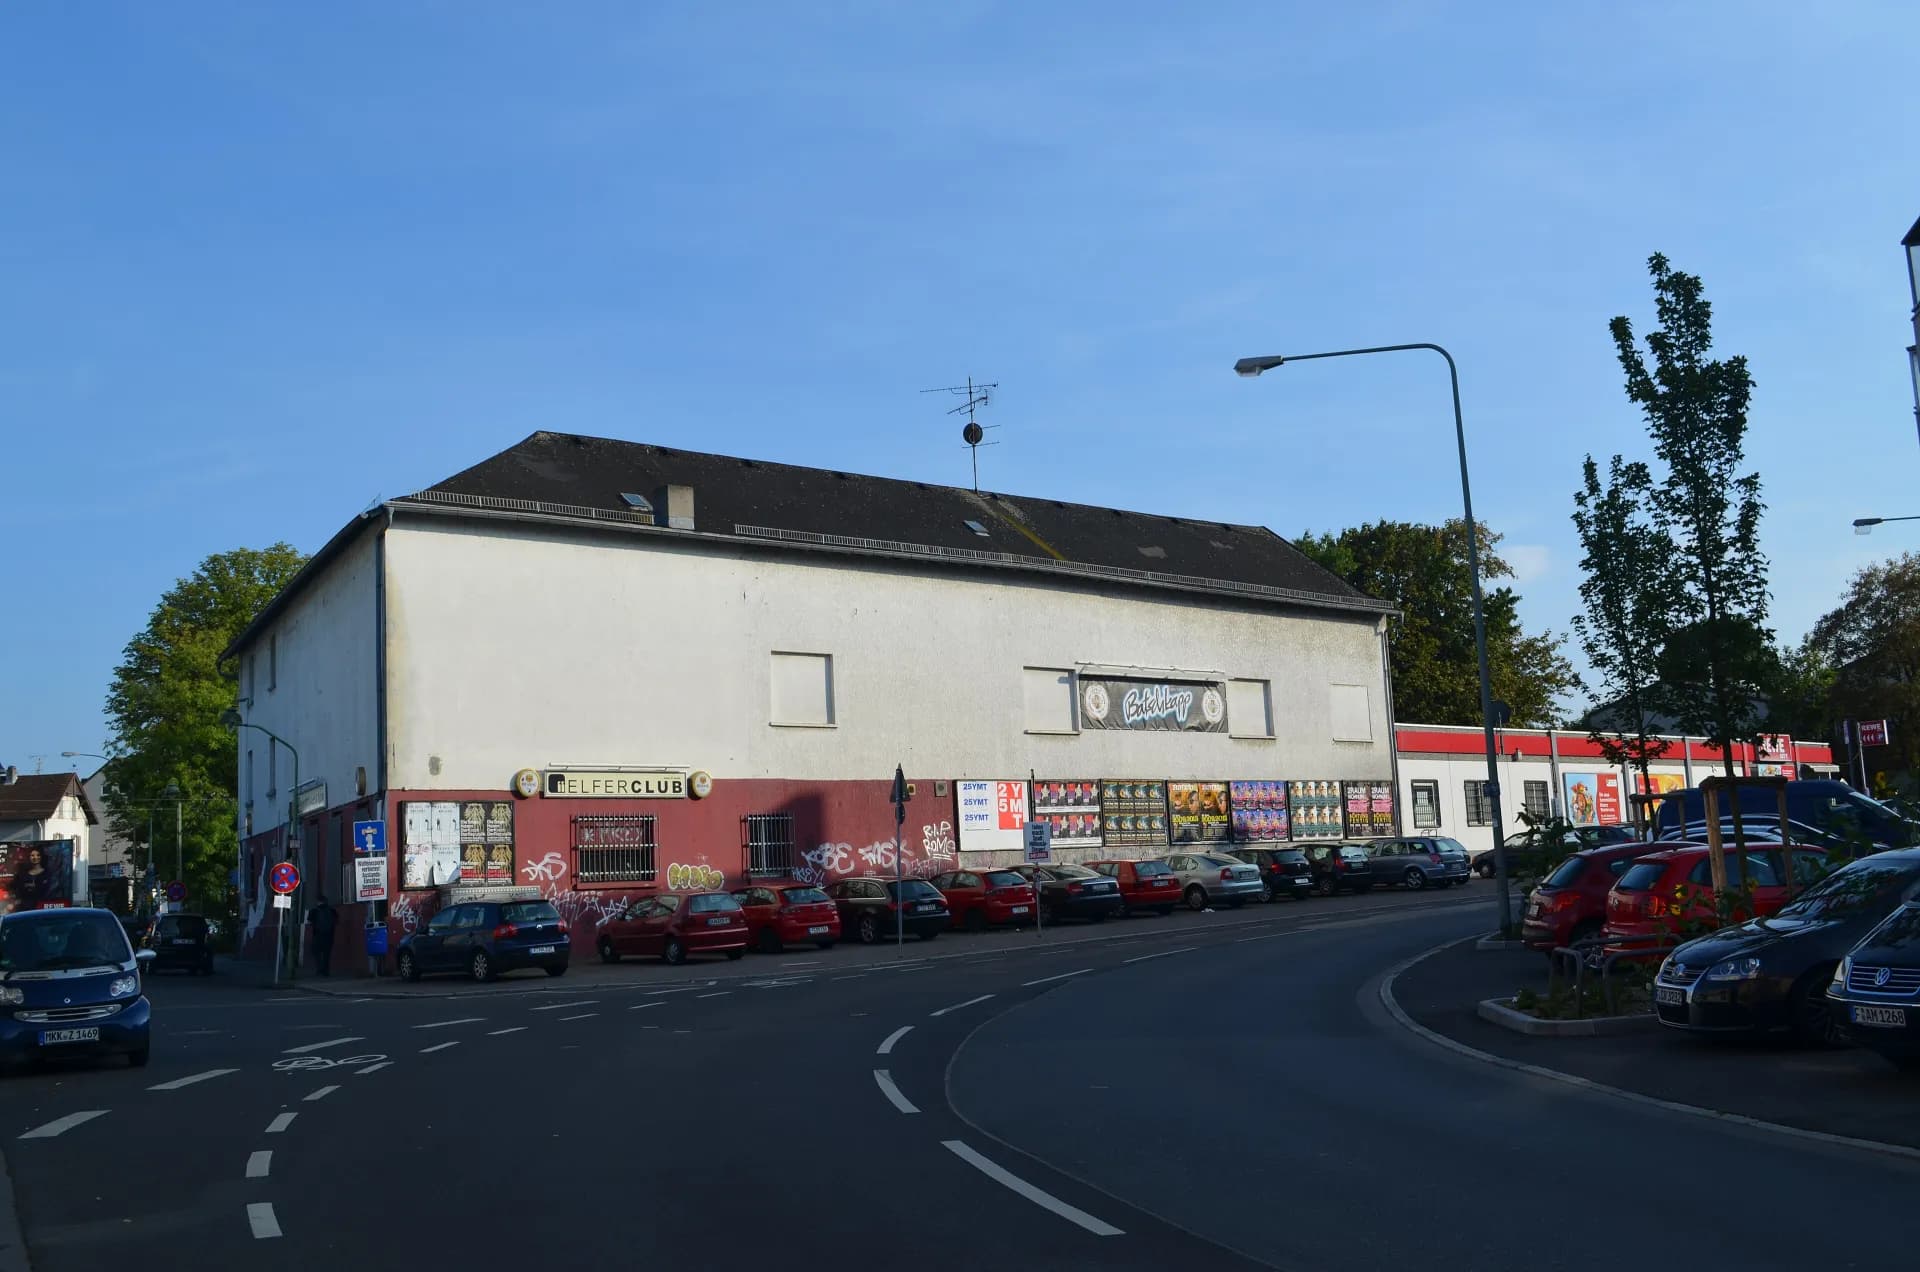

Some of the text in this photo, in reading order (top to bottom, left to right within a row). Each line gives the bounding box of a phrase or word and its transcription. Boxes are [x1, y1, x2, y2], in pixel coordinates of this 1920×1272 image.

[1124, 685, 1192, 723] Batschkapp
[1861, 723, 1882, 731] REWE
[963, 783, 988, 791] 25YMT
[76, 1029, 98, 1039] 1469
